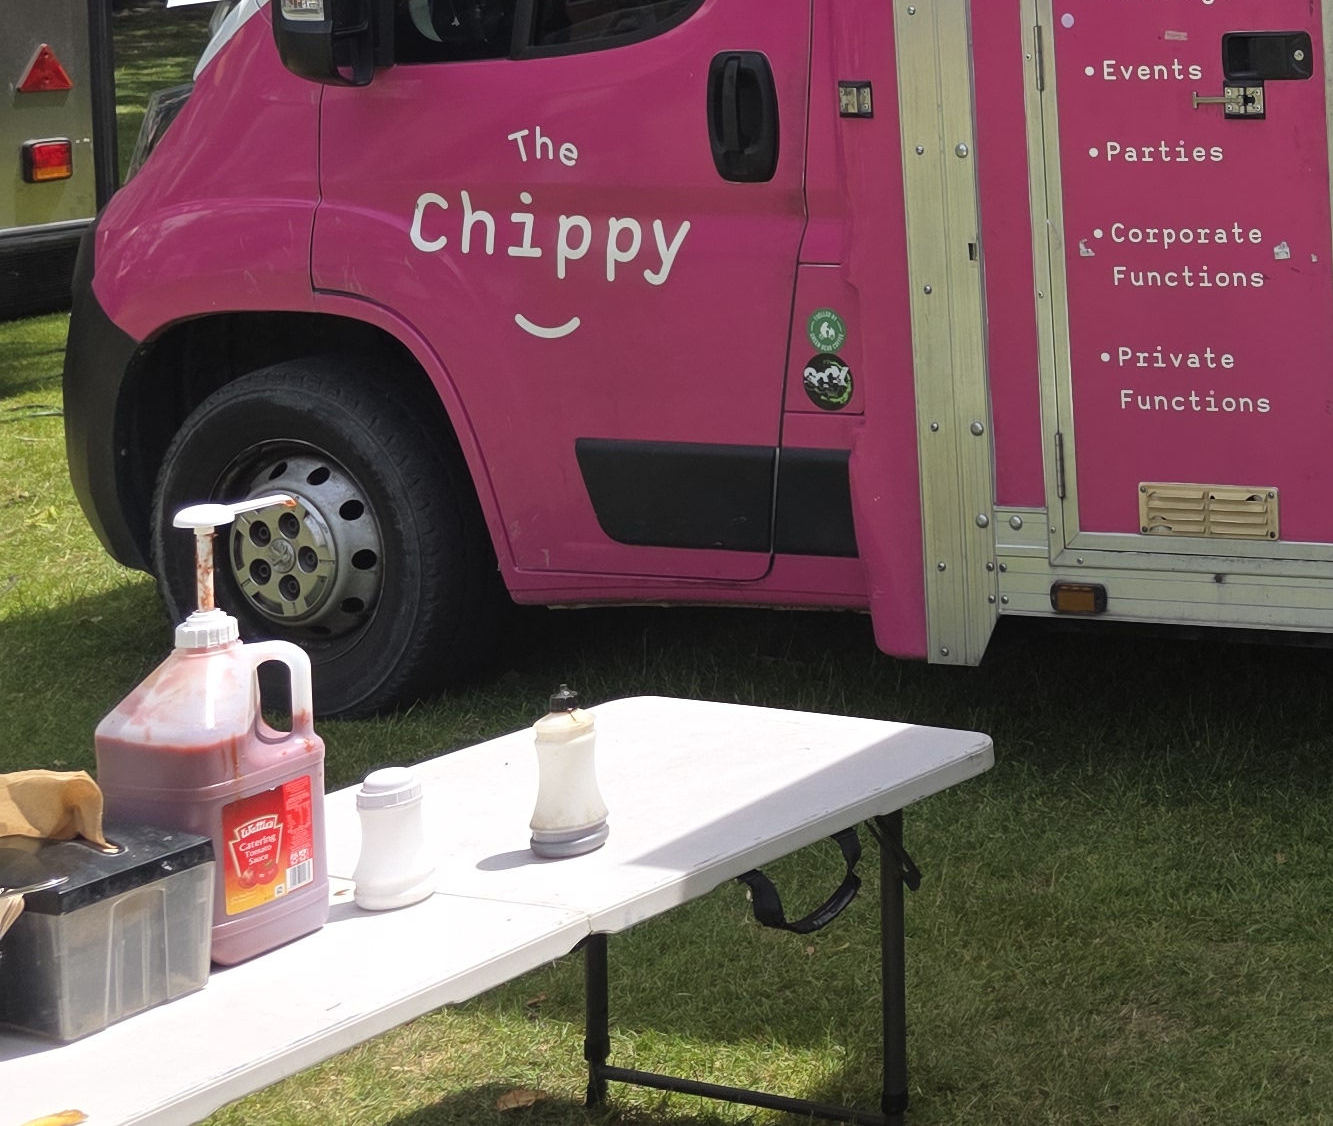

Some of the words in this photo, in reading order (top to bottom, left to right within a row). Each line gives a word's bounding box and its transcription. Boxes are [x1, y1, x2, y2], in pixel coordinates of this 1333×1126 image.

[1102, 60, 1202, 81] Events
[508, 125, 579, 167] The
[1106, 140, 1224, 163] Parties
[410, 190, 691, 286] Chippy
[1110, 219, 1263, 248] Corporate
[1113, 265, 1265, 288] Functions
[1117, 345, 1235, 369] Private
[1120, 390, 1271, 413] Functions
[239, 834, 276, 852] Catering
[248, 854, 269, 865] Sauce
